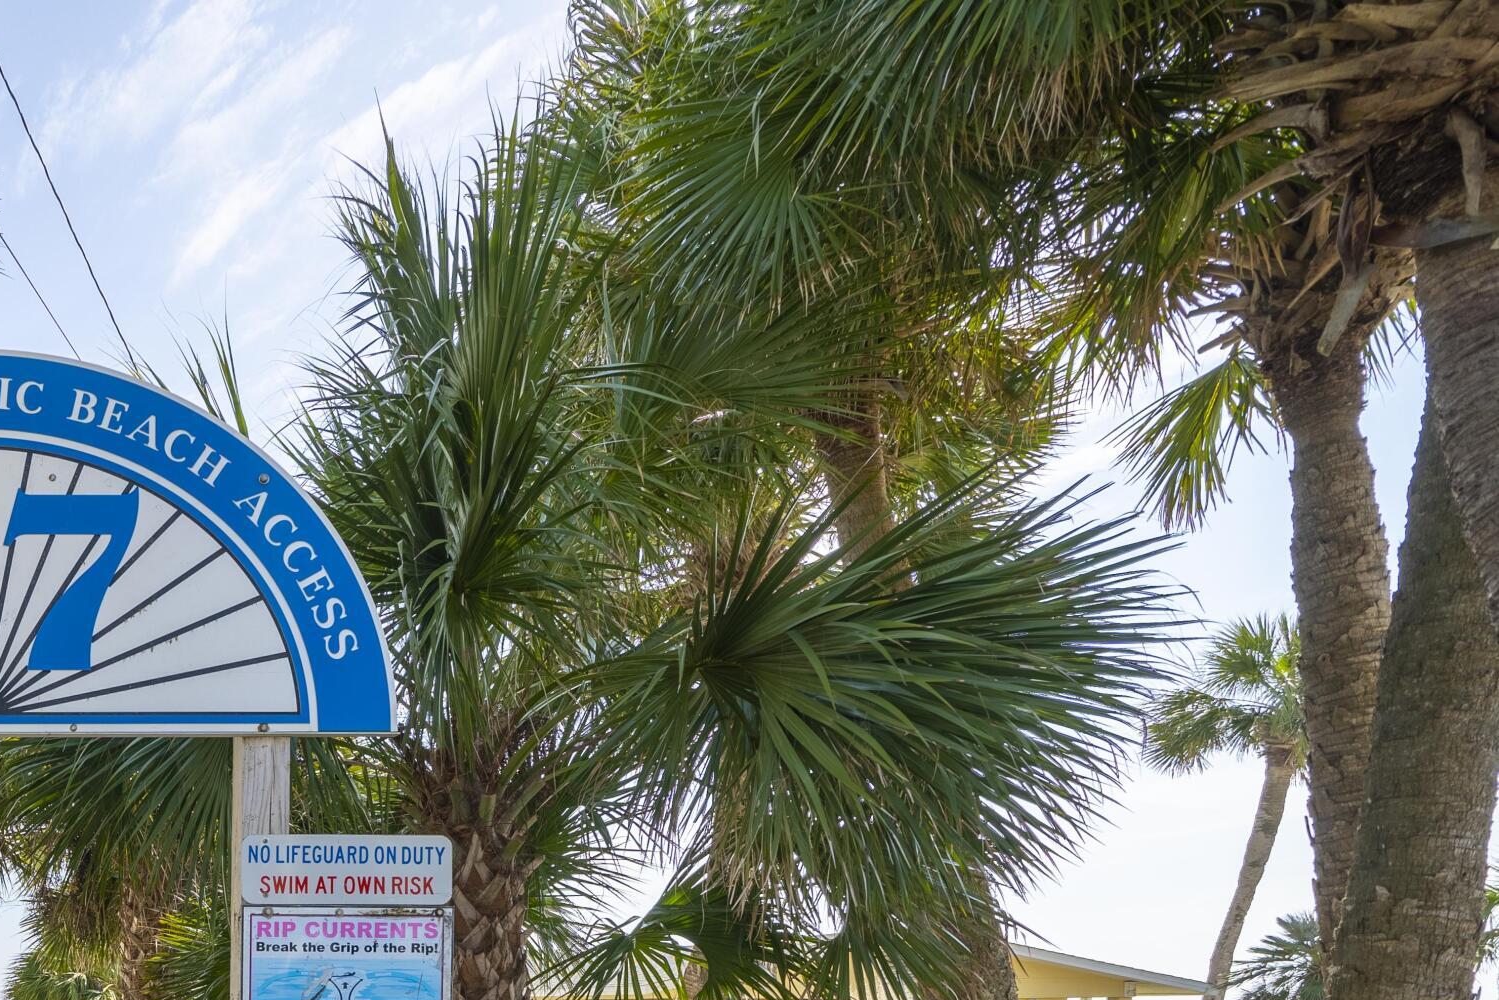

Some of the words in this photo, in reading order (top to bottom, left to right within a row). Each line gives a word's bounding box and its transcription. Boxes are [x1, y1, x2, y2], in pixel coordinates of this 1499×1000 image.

[66, 388, 231, 486] BEACH
[234, 491, 359, 660] ACCESS
[248, 845, 270, 864] NO
[276, 845, 369, 864] LIFEGUARD
[374, 846, 397, 865] ON
[402, 847, 445, 865] DUTY
[260, 876, 308, 895] SWIM
[315, 876, 337, 894] AT
[344, 876, 385, 894] OWN
[392, 877, 434, 895] RISK
[257, 921, 296, 938] RIP
[305, 921, 439, 939] CURRENTS
[256, 942, 297, 952] Break
[303, 942, 325, 953] the
[330, 943, 359, 955] Grip
[364, 942, 379, 953] of
[383, 943, 405, 953] the
[411, 943, 438, 955] Rip!
